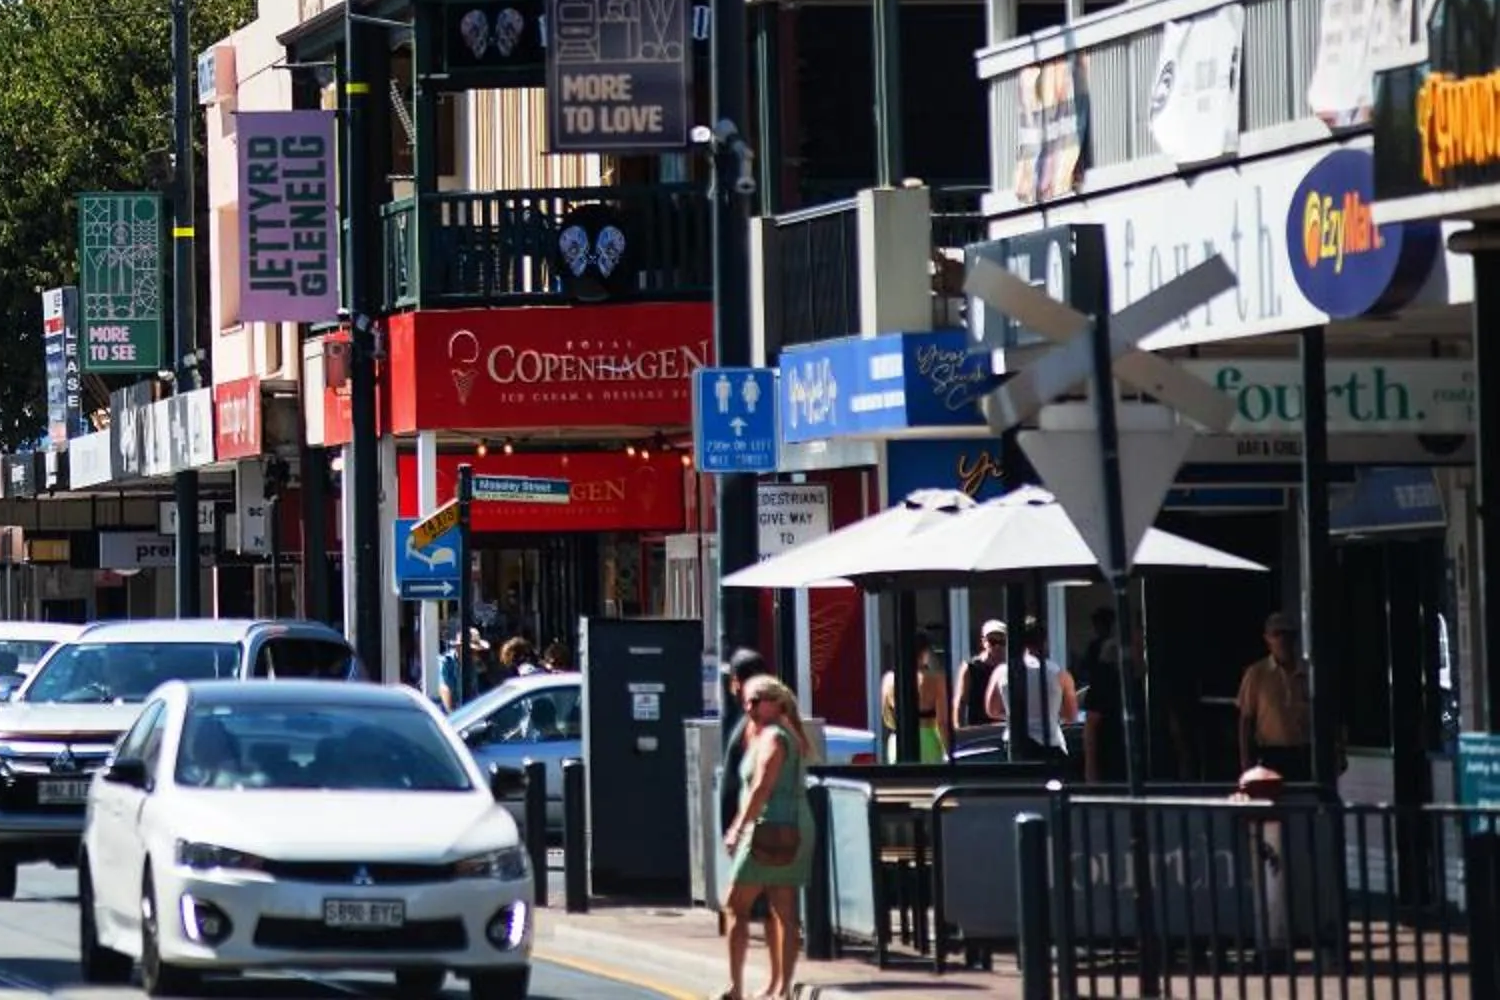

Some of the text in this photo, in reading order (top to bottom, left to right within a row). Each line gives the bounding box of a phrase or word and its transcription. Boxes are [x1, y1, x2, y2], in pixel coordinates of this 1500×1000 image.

[563, 74, 632, 101] MORE
[563, 105, 663, 133] TO LOVE
[282, 136, 328, 296] GLENELG
[89, 326, 130, 342] MORE
[89, 345, 137, 361] TO SEE
[487, 341, 709, 384] COPENHAGEN
[521, 481, 551, 493] Street
[759, 492, 824, 505] DESTRIANS
[760, 511, 813, 525] GIVE WAY
[781, 532, 795, 545] TO
